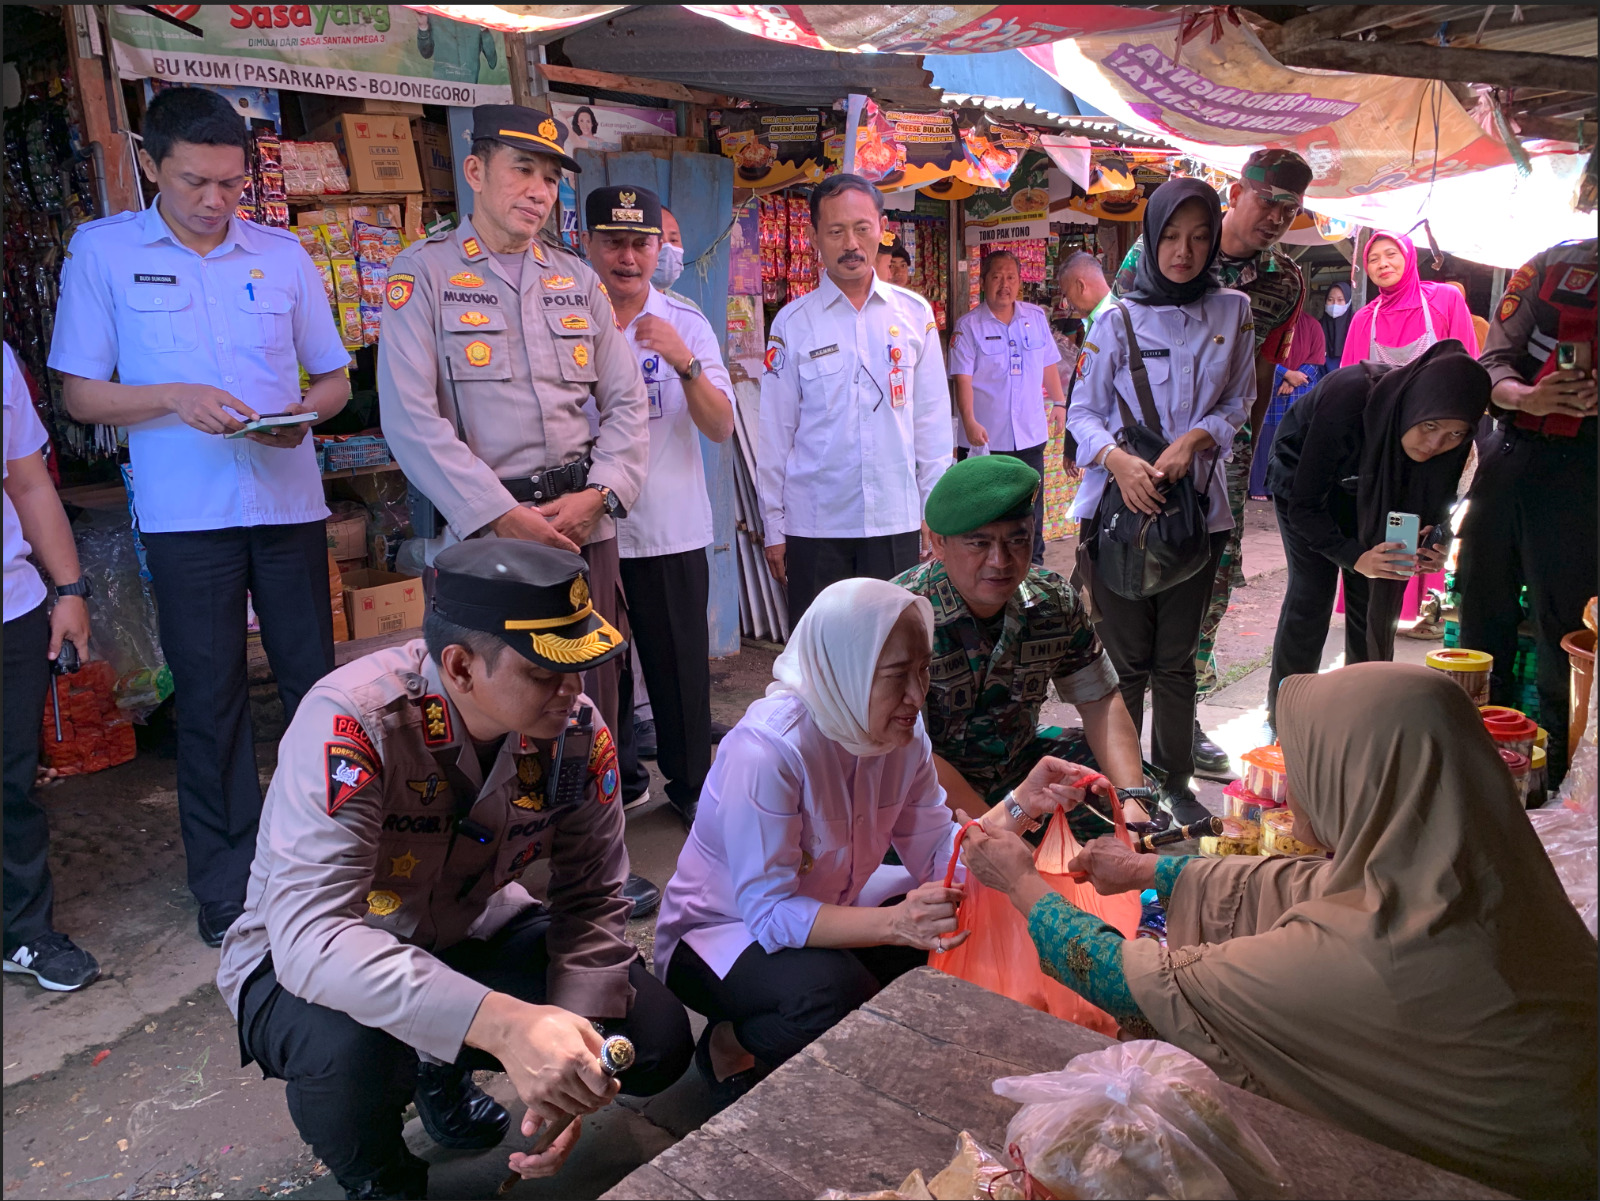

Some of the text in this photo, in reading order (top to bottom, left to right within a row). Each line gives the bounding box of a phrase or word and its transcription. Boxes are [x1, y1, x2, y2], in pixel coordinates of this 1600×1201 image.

[248, 35, 385, 47] DIMULAI DARI SASA SANTAN OMEGA 3
[153, 57, 180, 76] BU
[185, 60, 231, 79] KUM
[793, 124, 816, 132] BULDAK
[896, 123, 951, 134] CHEESE BULDAK
[979, 226, 1030, 242] TOKO PAK YONO
[443, 291, 499, 305] MULYONO
[542, 295, 589, 307] POLRI
[1030, 643, 1051, 657] TNI
[943, 655, 966, 672] YUDO
